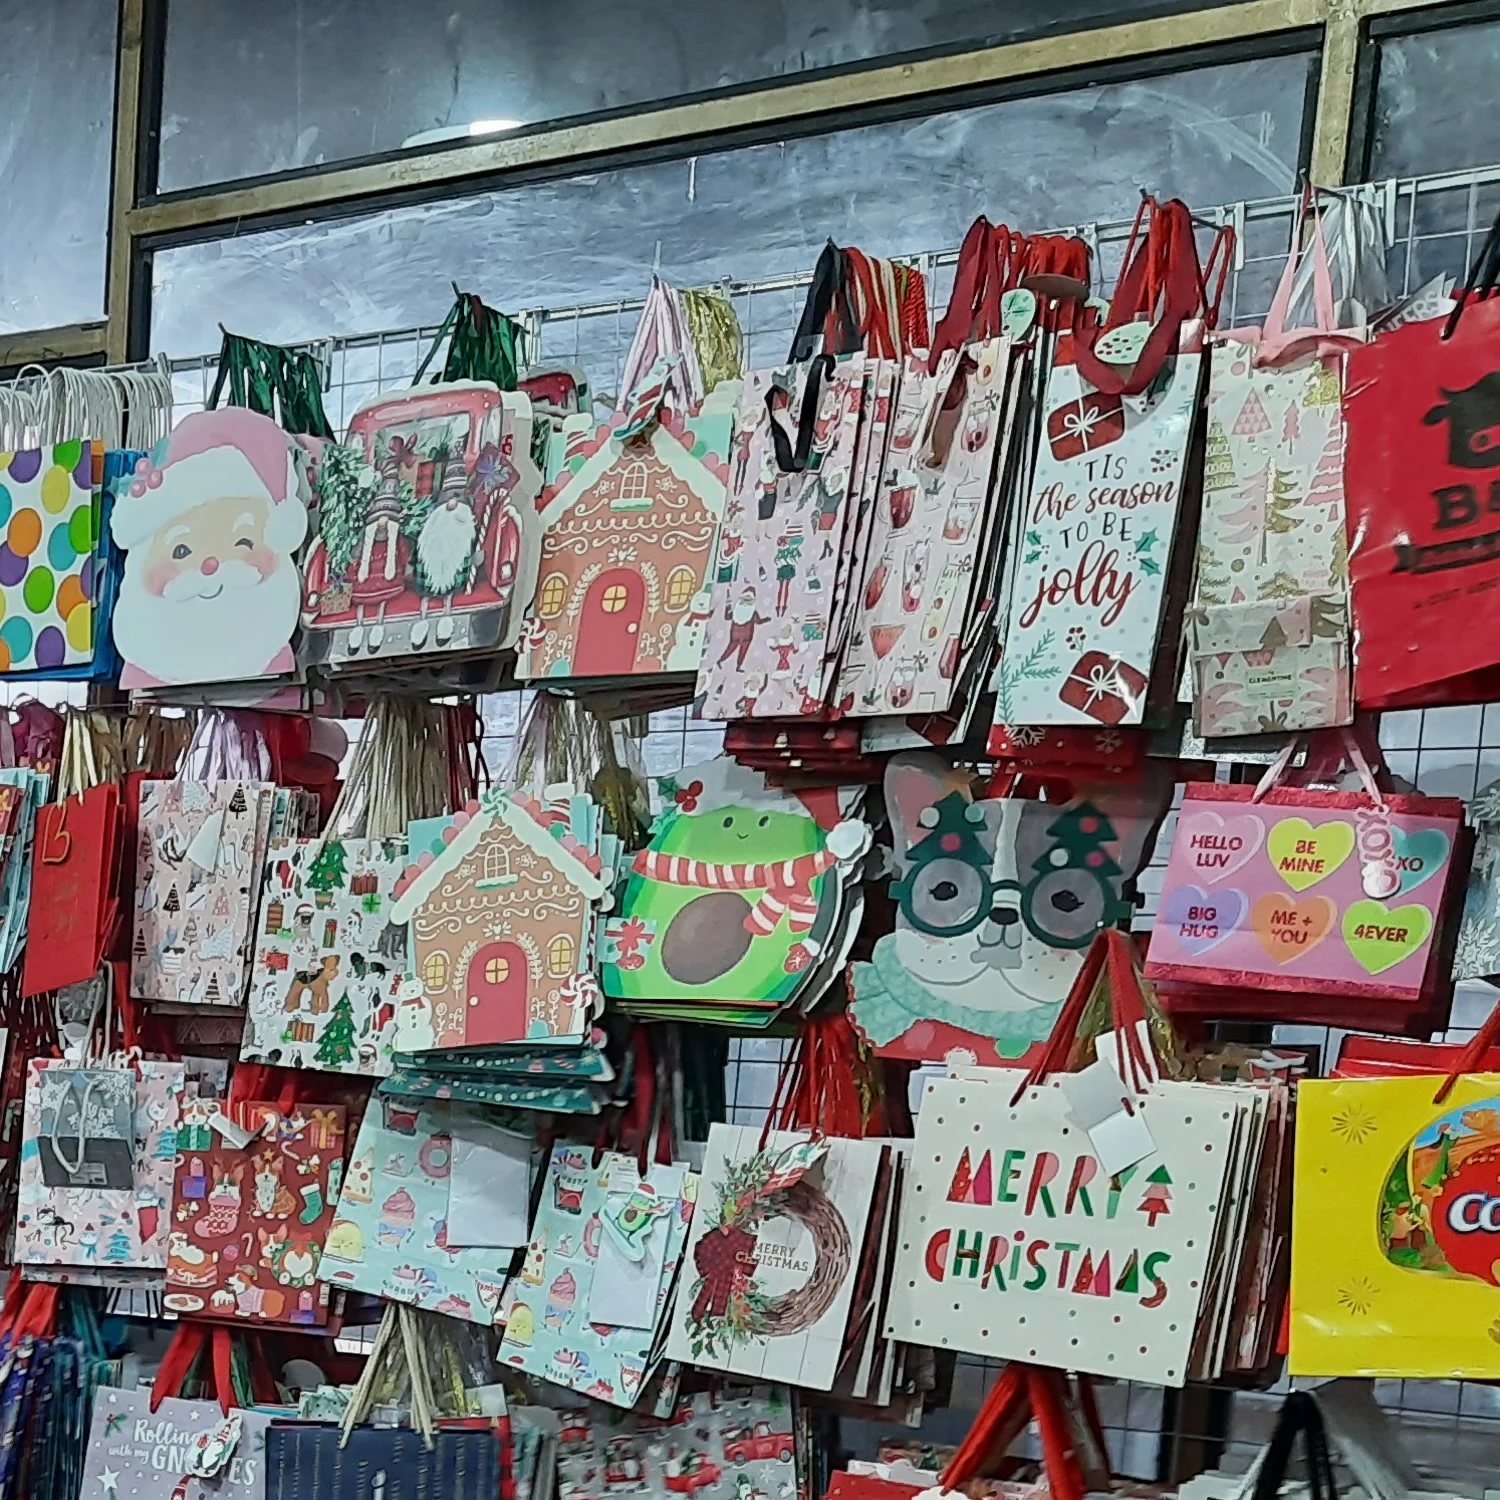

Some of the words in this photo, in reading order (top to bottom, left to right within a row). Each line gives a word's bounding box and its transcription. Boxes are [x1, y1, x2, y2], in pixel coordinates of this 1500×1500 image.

[1033, 482, 1081, 524] the
[1085, 481, 1178, 513] season
[1059, 521, 1089, 548] TO
[1102, 512, 1133, 542] BE
[1019, 540, 1141, 628] jolly
[1190, 834, 1243, 851] HELLO
[1295, 839, 1318, 855] BE
[1196, 852, 1231, 868] LUV
[1279, 856, 1325, 873] MINE
[1188, 906, 1217, 921] BIG
[1270, 909, 1298, 926] ME
[1179, 923, 1219, 939] HUG
[1271, 928, 1309, 944] YOU
[1354, 924, 1408, 942] 4EVER
[134, 1448, 150, 1465] my
[152, 1444, 258, 1486] GNES
